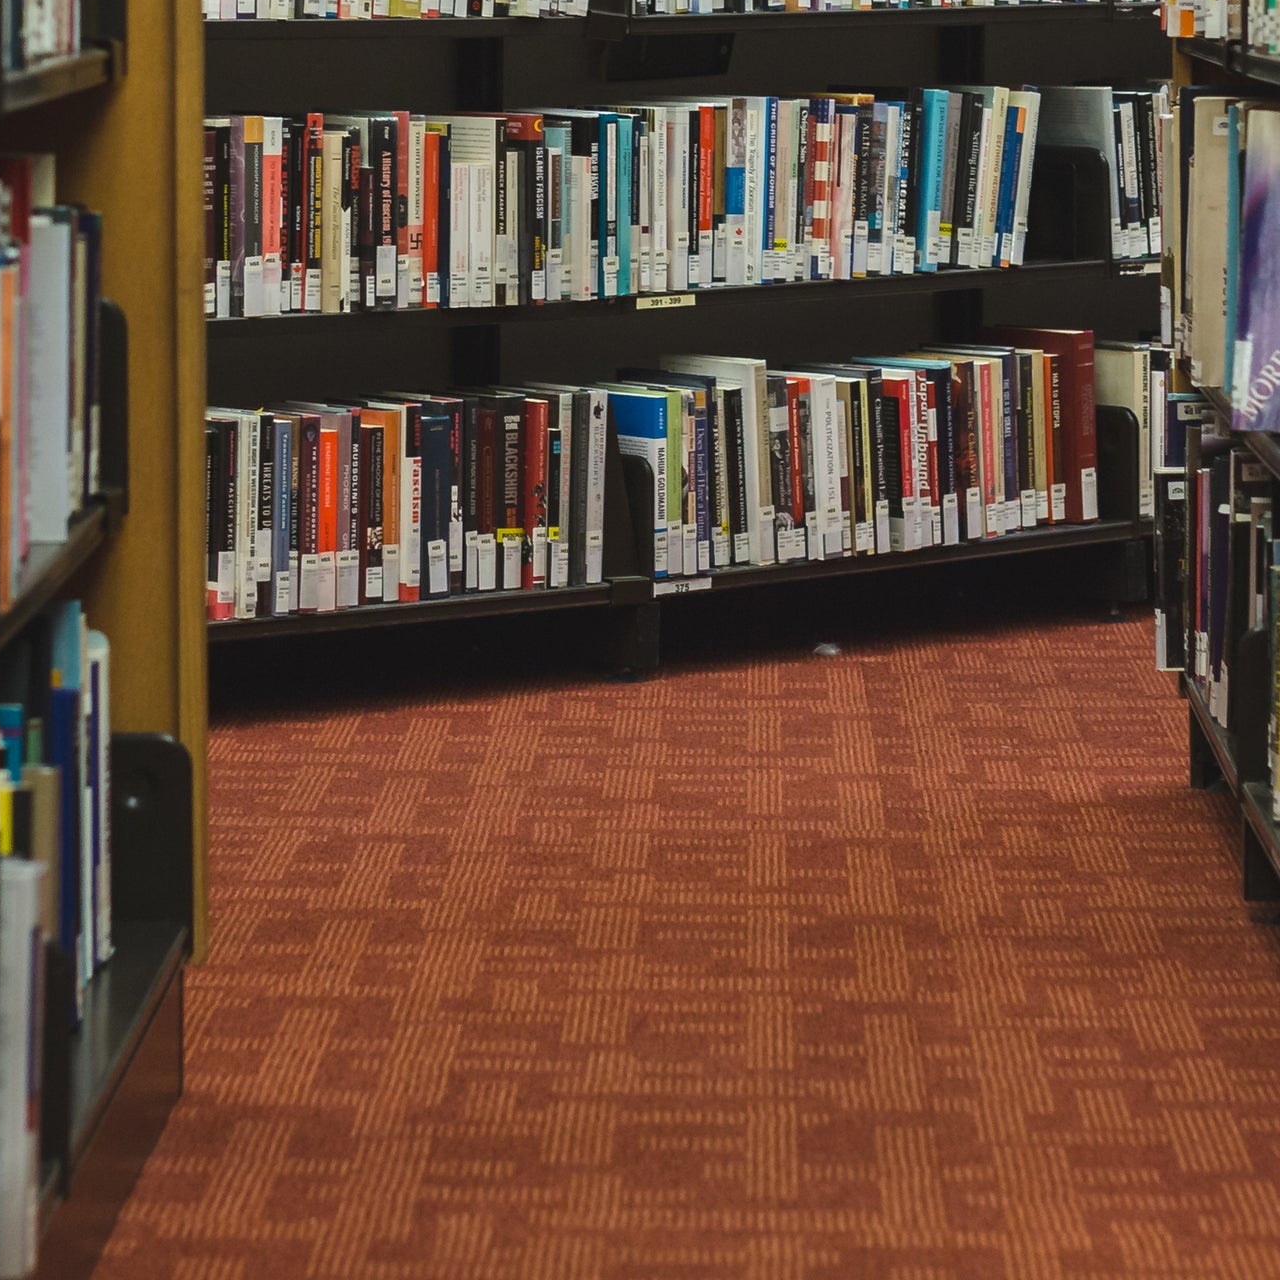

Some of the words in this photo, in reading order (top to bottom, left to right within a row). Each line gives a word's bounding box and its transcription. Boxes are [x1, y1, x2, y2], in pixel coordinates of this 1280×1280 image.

[748, 134, 756, 147] The
[800, 110, 808, 144] Original
[748, 148, 756, 175] Tragedy
[770, 156, 777, 168] OF
[800, 145, 808, 163] Sins
[968, 132, 980, 165] Settling
[993, 135, 1002, 173] DEFINING
[380, 158, 392, 188] History
[536, 147, 544, 181] ISLAMIC
[970, 166, 977, 176] in
[382, 190, 392, 198] of
[748, 176, 756, 184] of
[968, 178, 977, 191] the
[536, 183, 544, 219] FASCISM
[748, 184, 756, 213] Zionism
[966, 193, 975, 222] Hearts
[989, 175, 998, 222] NEIGHBORS
[381, 200, 392, 233] Fascism,
[650, 299, 663, 307] 391
[669, 297, 682, 305] 399
[918, 376, 928, 421] Japan
[1053, 389, 1060, 398] to
[1142, 394, 1149, 405] AT
[697, 428, 707, 451] Does
[827, 410, 836, 475] POLITICIZATION
[505, 433, 518, 505] BLACKSHIRT
[658, 448, 666, 476] NAHUM
[697, 452, 707, 478] Israel
[918, 423, 930, 490] Unbound
[262, 462, 273, 500] THREATS
[343, 465, 351, 511] PHOENIX
[412, 458, 421, 524] Fascism
[698, 479, 707, 502] Have
[262, 505, 271, 516] TO
[658, 477, 666, 520] GOLDMANN
[698, 511, 707, 540] Future
